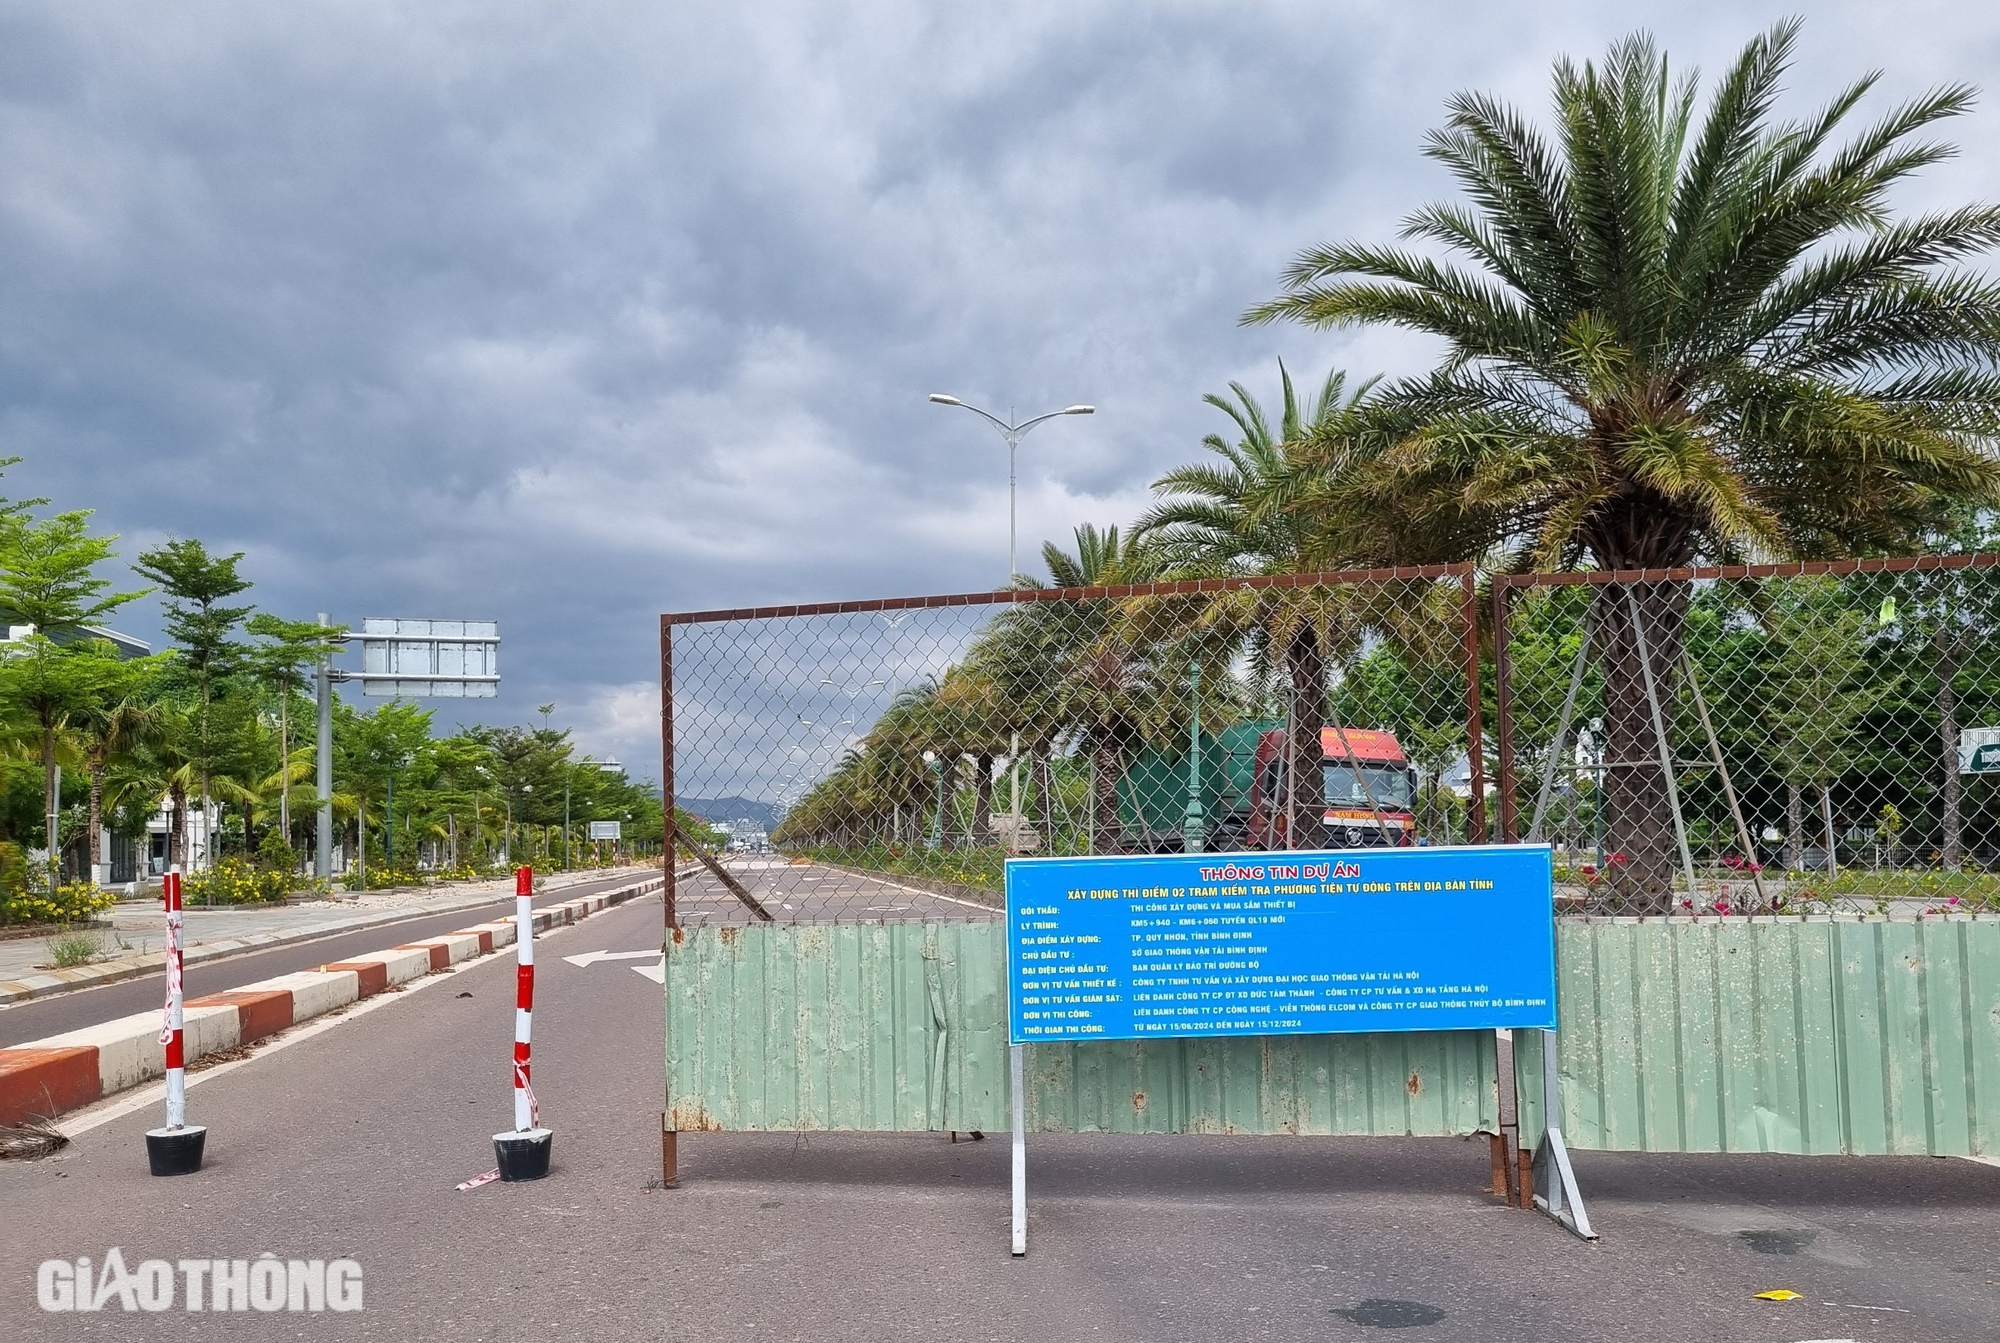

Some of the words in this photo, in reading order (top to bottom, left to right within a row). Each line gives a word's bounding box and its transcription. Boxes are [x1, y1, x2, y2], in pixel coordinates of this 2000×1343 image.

[1200, 864, 1265, 881] THÔNG
[1268, 865, 1299, 880] TIN
[1303, 862, 1330, 881] DỰ
[1332, 860, 1360, 878] ÁN
[1067, 888, 1087, 900] XÂY
[1090, 888, 1119, 901] DỰNG
[1121, 886, 1139, 898] THÍ
[1141, 884, 1169, 898] ĐIỂM
[1171, 887, 1185, 898] 02
[1188, 886, 1218, 898] TRẠM
[1221, 882, 1247, 896] KIỂM
[1250, 885, 1271, 895] TRA
[1273, 883, 1317, 895] PHƯƠNG
[1319, 881, 1343, 895] TIỆN
[1346, 882, 1360, 894] TỰ
[1362, 880, 1391, 894] ĐỘNG
[1394, 879, 1421, 892] TRÊN
[1423, 881, 1442, 892] ĐỊA
[1444, 878, 1466, 890] BÀN
[1468, 877, 1493, 890] TỈNH
[1130, 904, 1143, 912] THI
[1223, 902, 1241, 910] MUA
[1247, 916, 1268, 924] QL19
[1145, 934, 1161, 942] QUY
[1144, 948, 1163, 956] GIAO
[1132, 964, 1148, 972] BAN
[1156, 977, 1166, 986] TY
[1167, 977, 1190, 986] TNHH
[1310, 973, 1330, 982] GIAO
[1152, 992, 1175, 1001] DANH
[1200, 991, 1210, 1000] TY
[1211, 991, 1223, 999] CP
[1237, 991, 1249, 999] XD
[1349, 988, 1359, 996] TY
[1360, 987, 1372, 996] CP
[1404, 986, 1411, 995] &
[1412, 986, 1424, 994] XD
[1152, 1007, 1175, 1016] DANH
[1200, 1006, 1210, 1014] TY
[1212, 1006, 1224, 1014] CP
[1328, 1003, 1356, 1012] ELCOM
[1394, 1002, 1404, 1010] TY
[1405, 1001, 1417, 1009] CP
[1419, 1000, 1438, 1009] GIAO
[1257, 1019, 1301, 1028] 15/12/2024
[1044, 1026, 1063, 1034] GIAN
[1065, 1025, 1078, 1033] THI
